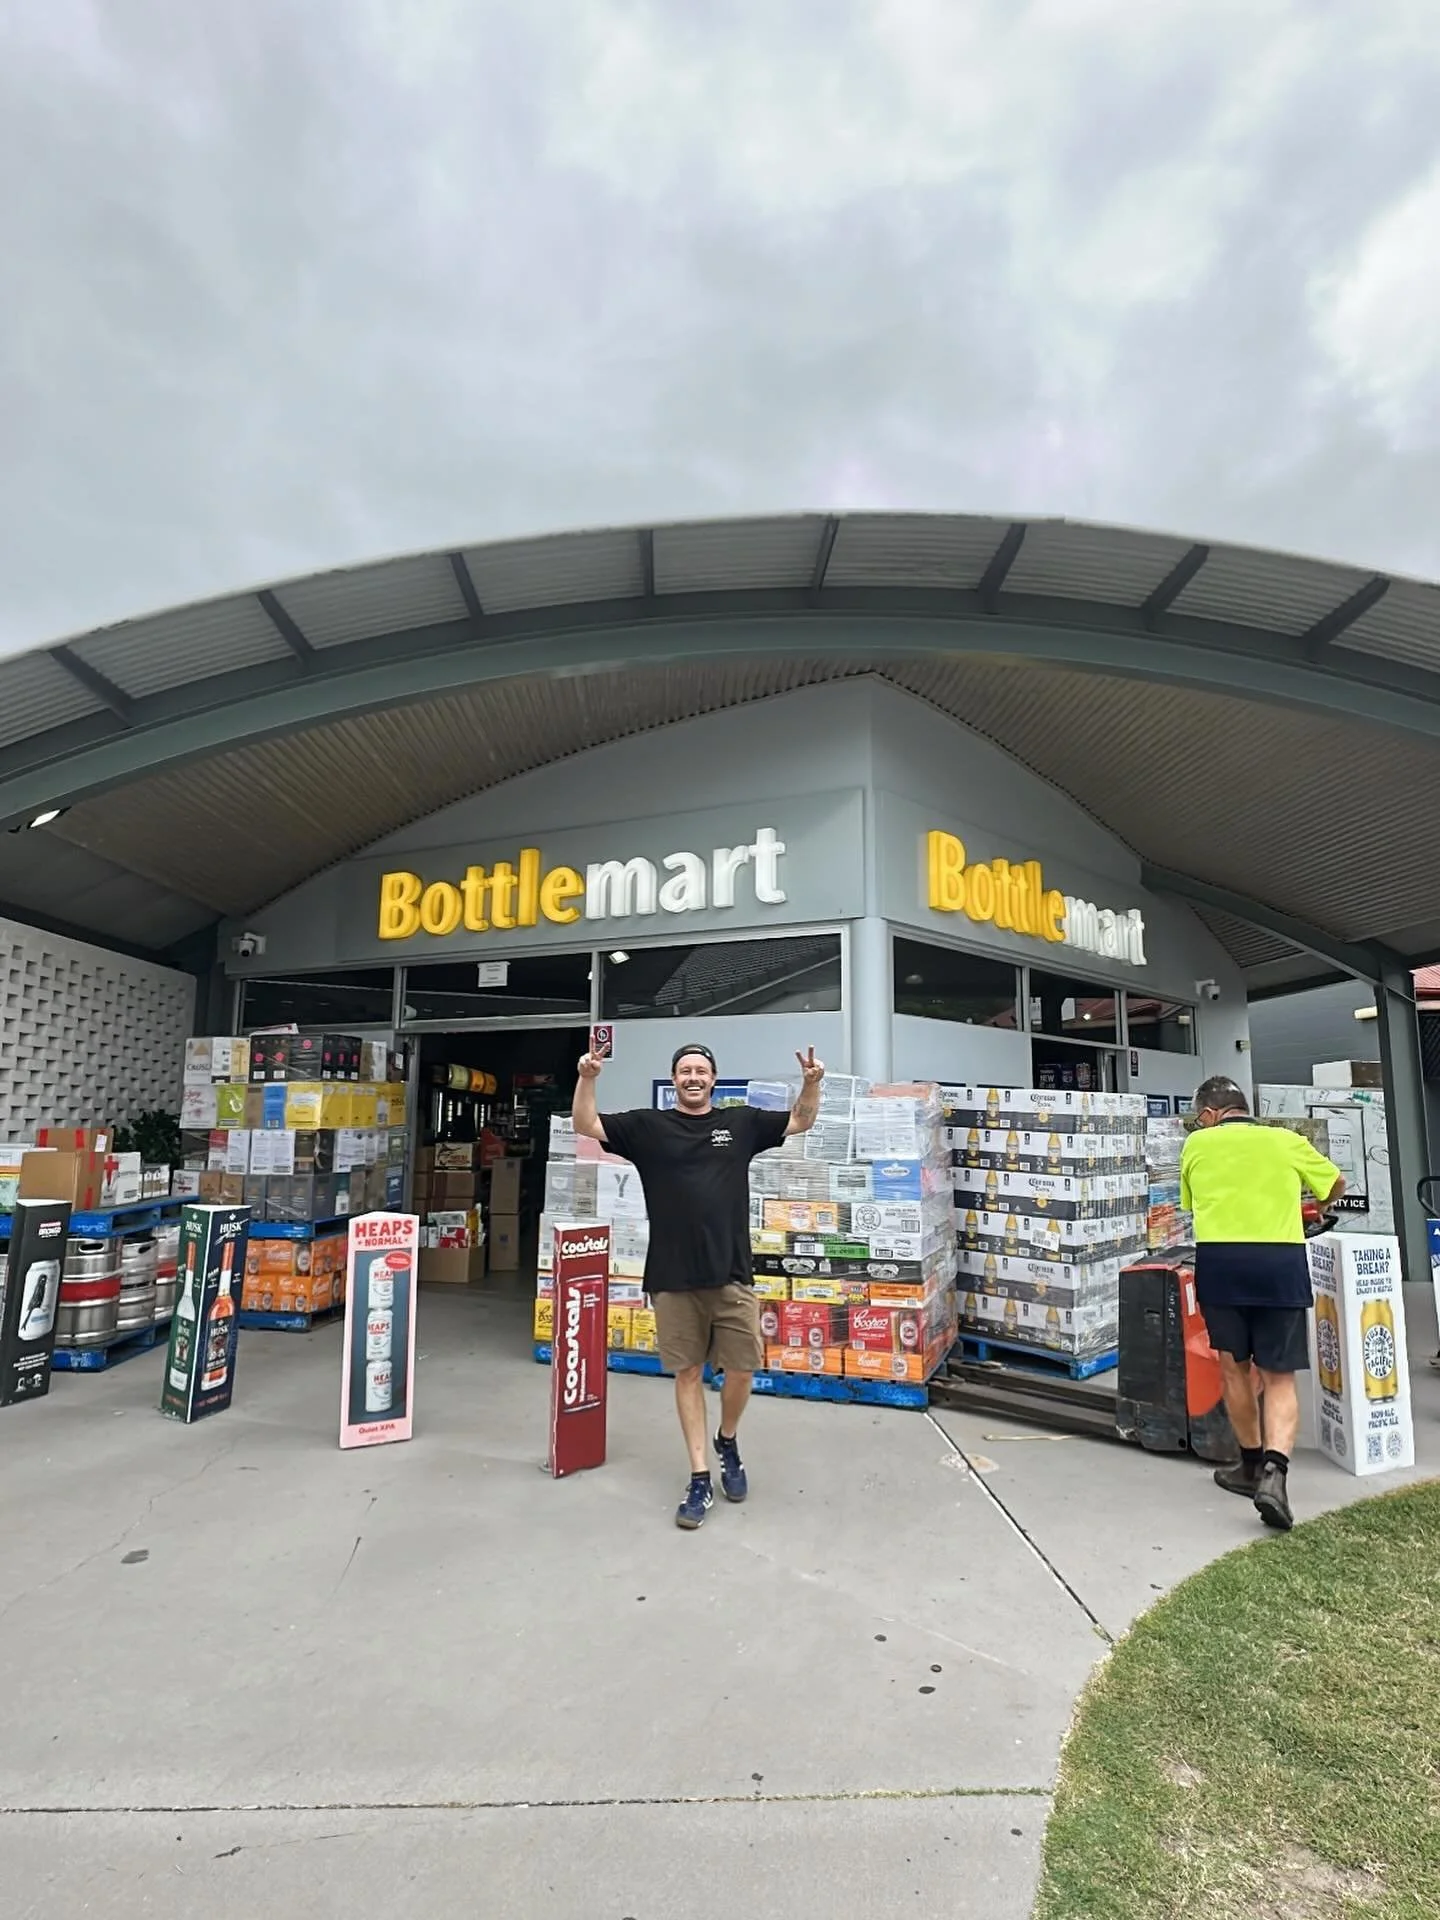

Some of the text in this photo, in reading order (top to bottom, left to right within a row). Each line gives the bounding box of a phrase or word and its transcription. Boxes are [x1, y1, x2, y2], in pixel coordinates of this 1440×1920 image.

[378, 827, 786, 940] Bottlemart
[928, 830, 1147, 965] Bottlemart
[1350, 1200, 1365, 1208] ICE
[220, 1221, 242, 1234] HUSK
[355, 1220, 413, 1238] HEAPS
[364, 1237, 403, 1247] NORMAL
[562, 1236, 609, 1254] Coastals
[1352, 1248, 1391, 1262] TAKING A
[1356, 1261, 1389, 1275] BREAK?
[854, 1309, 888, 1330] Coopers
[564, 1287, 581, 1405] Coastals
[1368, 1356, 1392, 1371] PACIFIC
